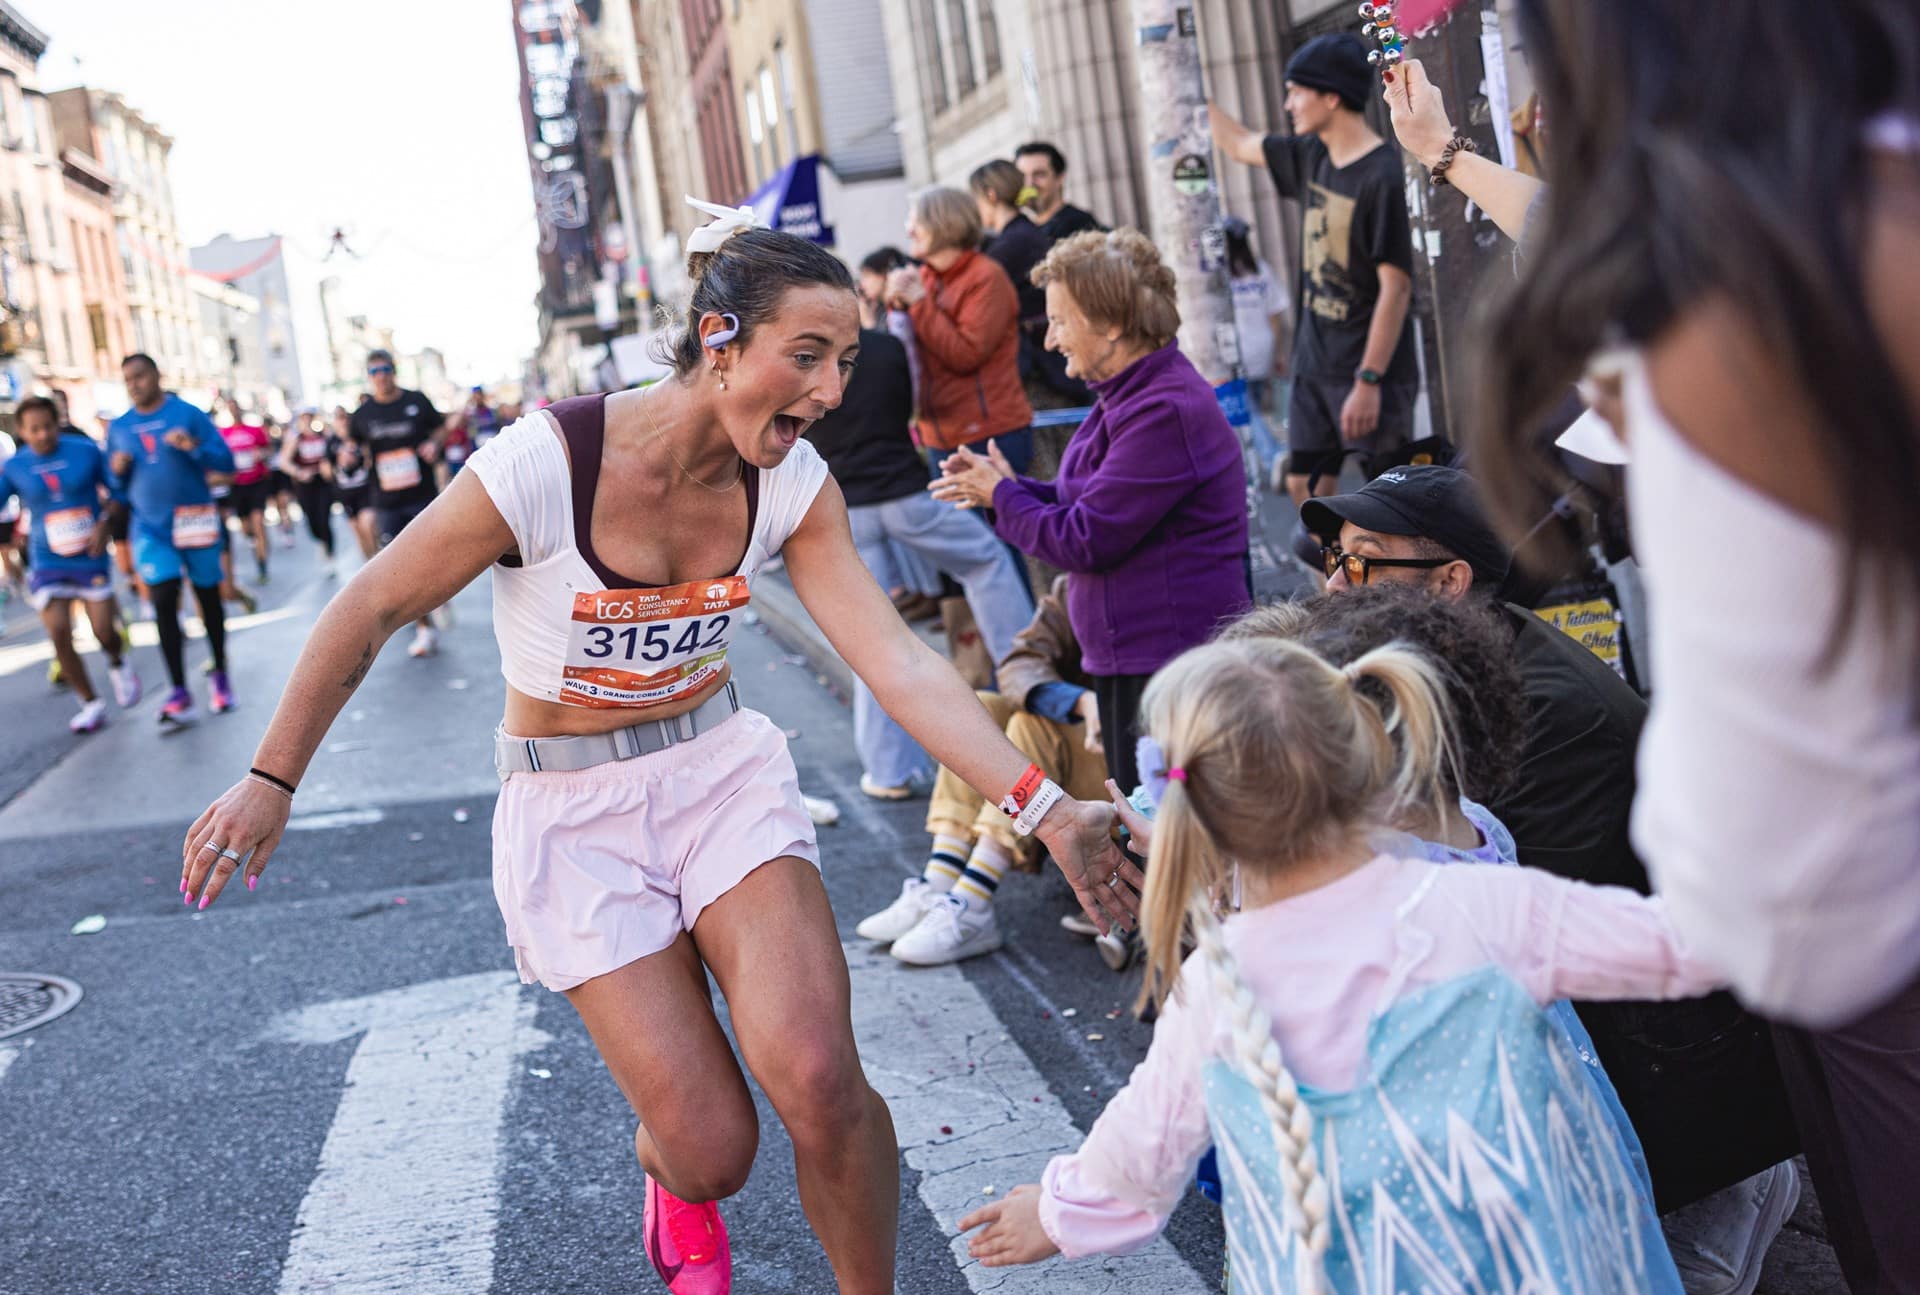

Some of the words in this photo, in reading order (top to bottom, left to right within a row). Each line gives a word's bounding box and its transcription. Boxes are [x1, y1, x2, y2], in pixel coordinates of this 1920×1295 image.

[638, 594, 661, 603] TATA
[638, 597, 690, 611] CONSULTANCY
[703, 599, 731, 610] TATA
[596, 597, 635, 620] tcs
[637, 607, 671, 618] SERVICES
[583, 614, 731, 662] 31542
[686, 664, 709, 686] 2025
[564, 680, 588, 692] WAVE
[588, 685, 598, 695] 3
[602, 690, 635, 700] ORANGE
[636, 690, 666, 699] CORRAL
[667, 684, 676, 693] C
